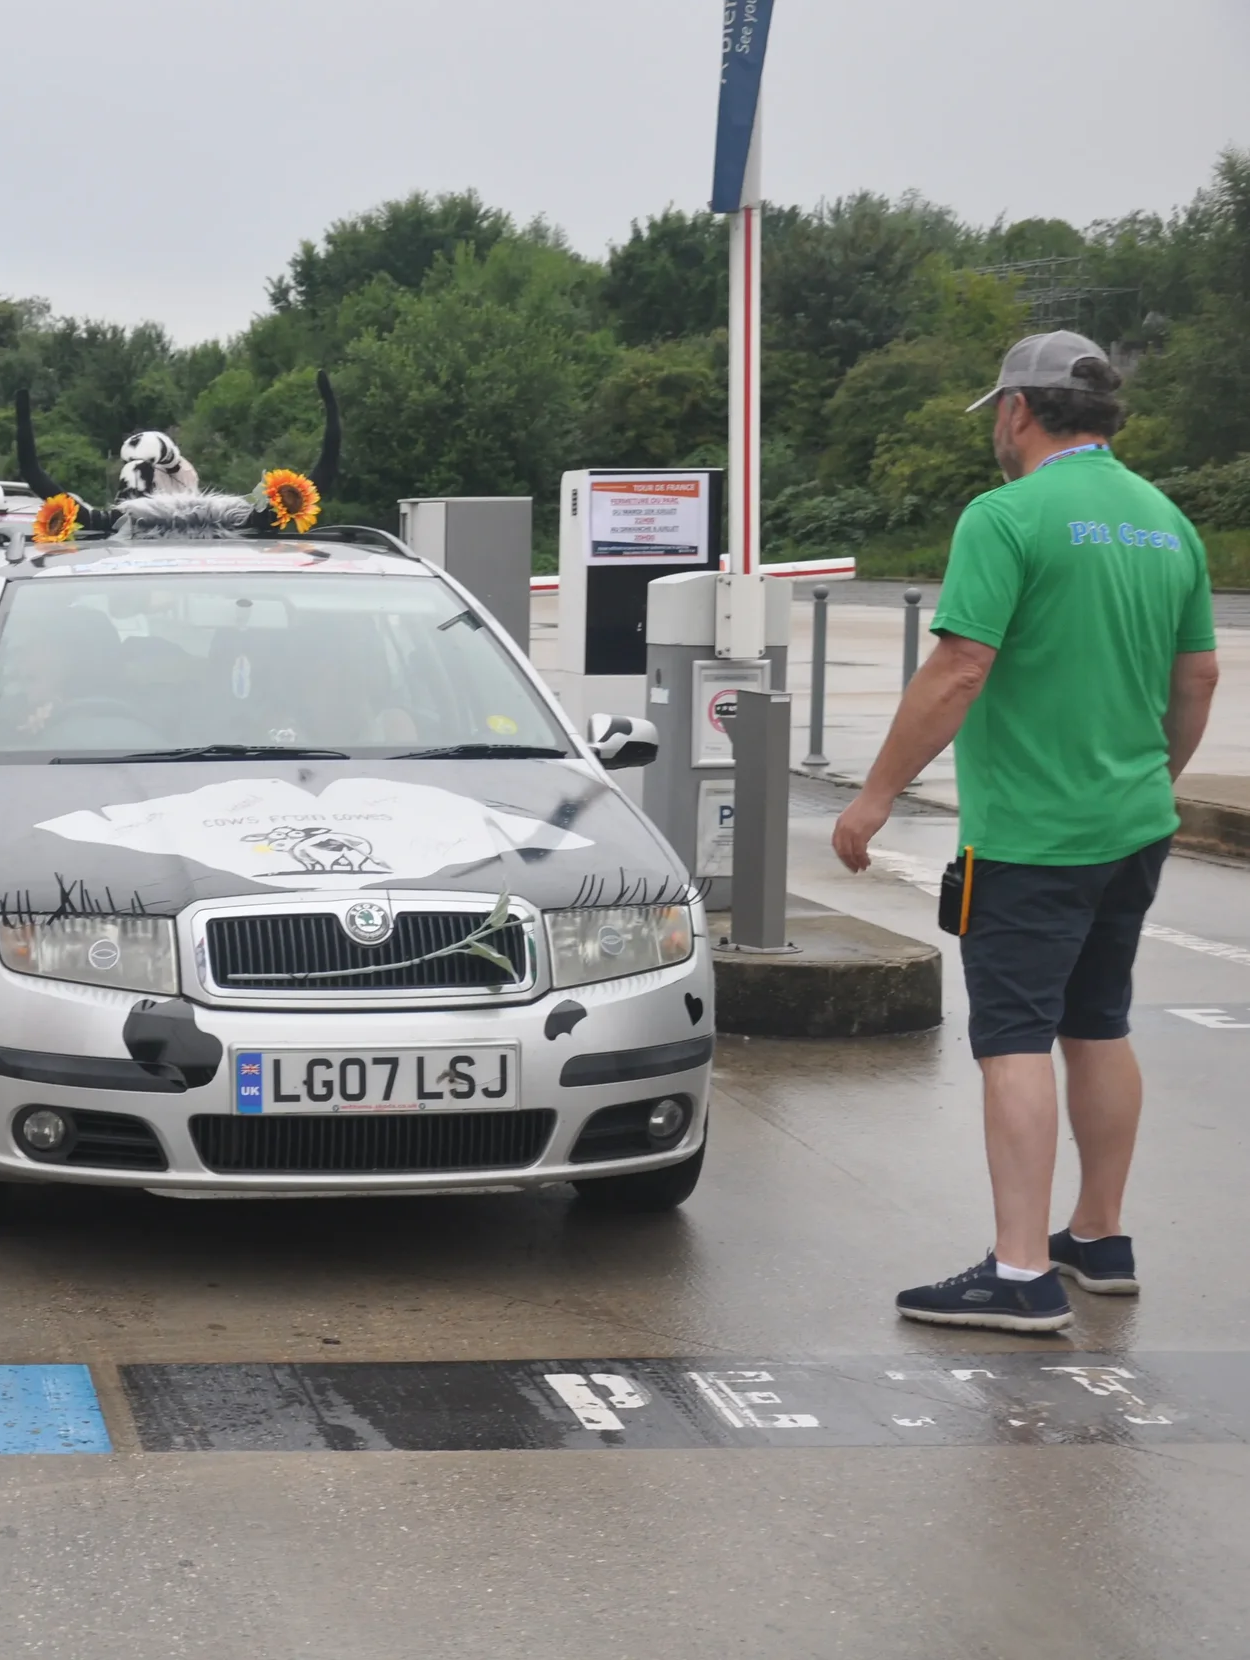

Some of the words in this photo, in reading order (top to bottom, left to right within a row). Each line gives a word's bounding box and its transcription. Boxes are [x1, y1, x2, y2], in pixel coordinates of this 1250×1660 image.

[735, 26, 754, 54] See
[633, 484, 654, 492] TOUR
[666, 483, 696, 491] FRANCE
[1068, 521, 1112, 545] Pit
[240, 1085, 261, 1096] UK
[273, 1056, 400, 1103] LG07
[416, 1054, 508, 1100] LSJ
